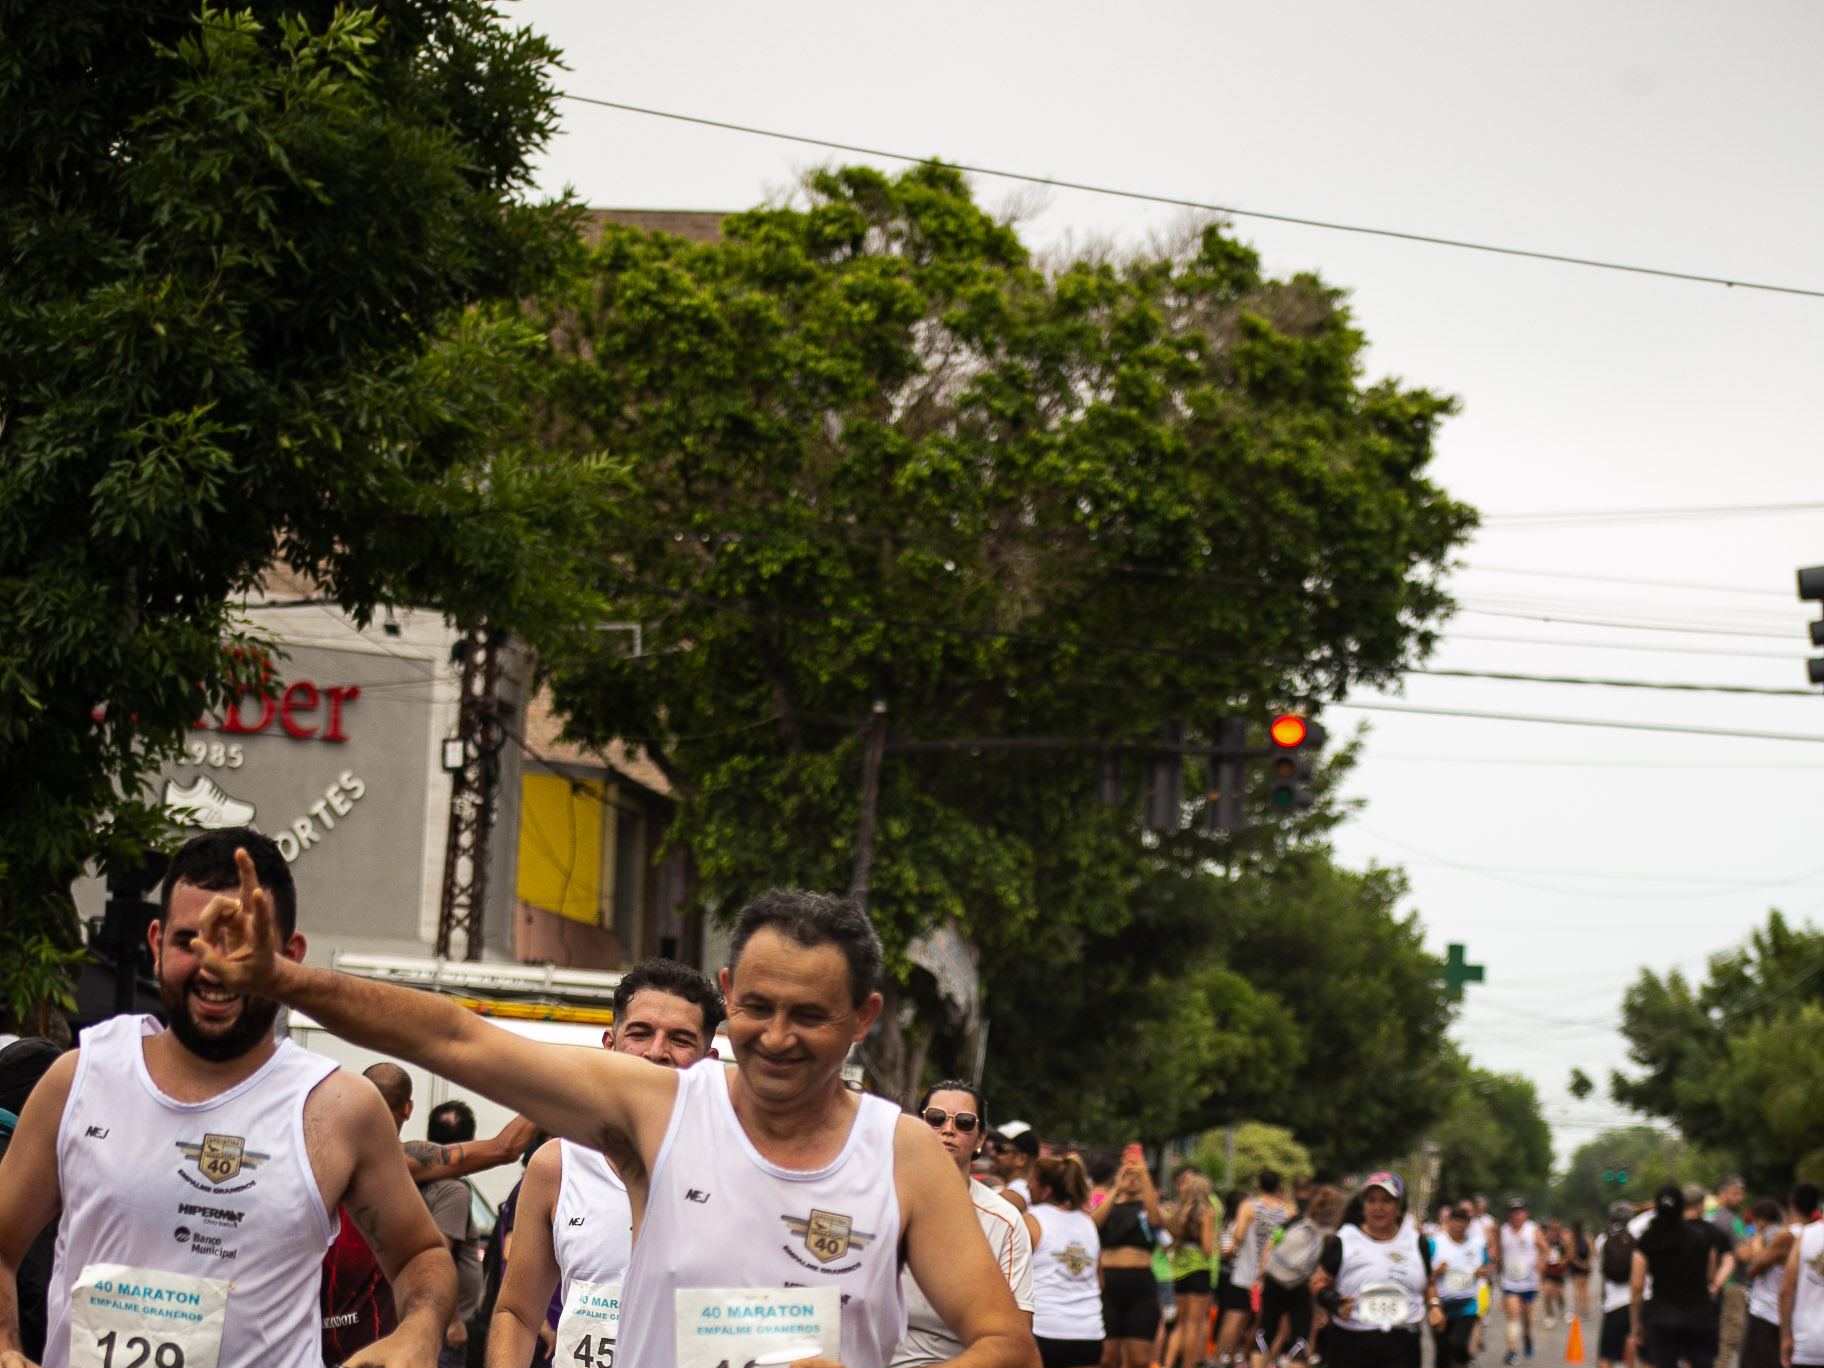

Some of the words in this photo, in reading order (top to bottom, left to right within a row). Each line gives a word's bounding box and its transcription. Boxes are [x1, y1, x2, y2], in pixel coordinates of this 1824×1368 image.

[173, 740, 244, 769] 985
[208, 1160, 231, 1175] 40
[569, 1217, 585, 1227] NEJ
[193, 1233, 222, 1246] Banco
[815, 1238, 838, 1255] 40
[191, 1243, 237, 1260] Municipal
[94, 1280, 113, 1293] 40
[118, 1282, 200, 1306] MARATON
[90, 1297, 140, 1313] EMPALME
[142, 1306, 204, 1322] GRANEROS
[592, 1297, 620, 1309] MAR
[702, 1306, 721, 1319] 40
[728, 1304, 814, 1318] MARATON
[697, 1326, 753, 1336] EMPALME
[757, 1324, 821, 1335] GRANEROS
